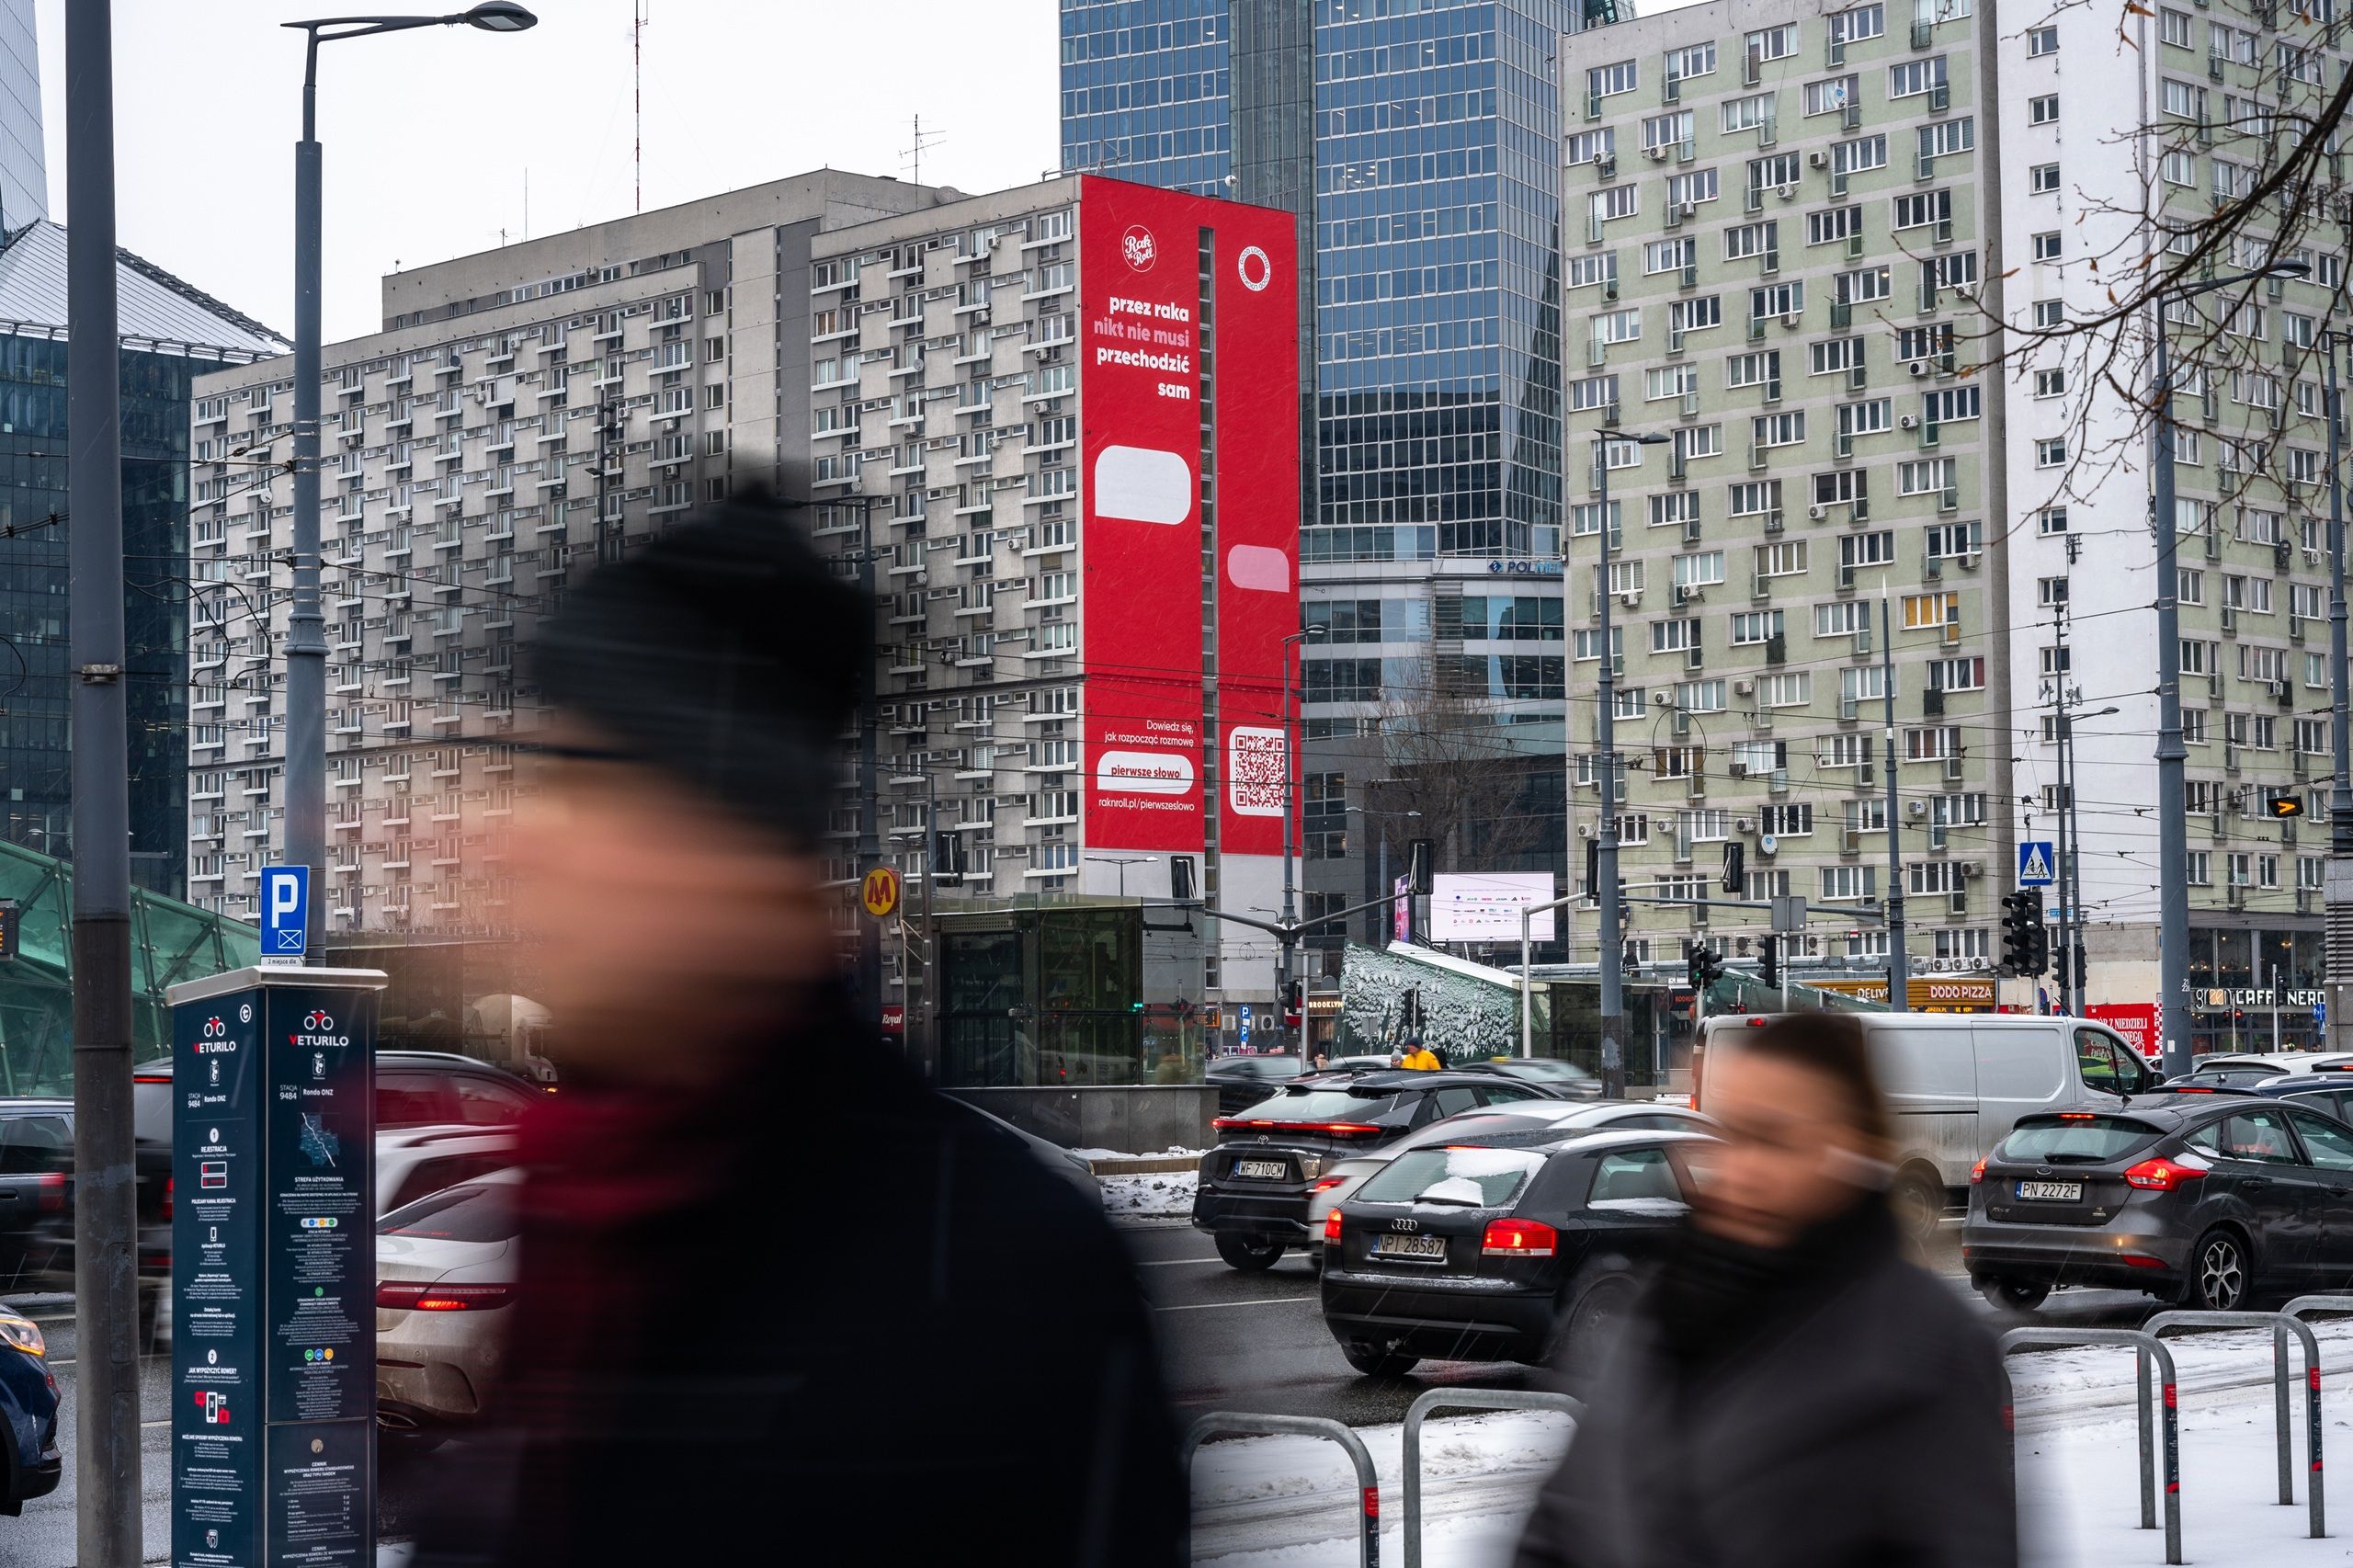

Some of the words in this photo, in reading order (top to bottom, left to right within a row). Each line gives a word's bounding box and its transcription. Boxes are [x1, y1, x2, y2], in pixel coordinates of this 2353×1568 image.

[1125, 234, 1153, 254] Rak
[1133, 247, 1154, 266] Roll
[1240, 248, 1250, 264] GOOD
[1251, 248, 1269, 269] LOOKING
[1240, 268, 1258, 289] LOOKING
[1259, 273, 1269, 288] GOOD
[1109, 296, 1151, 316] przez
[1154, 302, 1189, 322] raka
[1094, 317, 1124, 338] nikt
[1127, 322, 1150, 341] nie
[1154, 330, 1190, 348] musi
[1097, 347, 1190, 374] przechodzić
[1158, 382, 1190, 400] sam
[1147, 720, 1179, 732] Dowiedz
[1181, 723, 1194, 734] się,
[1104, 731, 1116, 743] jak
[1118, 734, 1158, 747] rozpocząć
[1160, 738, 1194, 748] rozmowę
[1111, 765, 1151, 778] pierwsze
[1154, 766, 1180, 779] słowo
[1099, 798, 1195, 812] raknroll.pl/pierwszeslowo
[271, 874, 298, 928] P
[1930, 986, 1959, 999] DODO
[1961, 986, 1992, 999] PIZZA
[2196, 989, 2232, 1009] green
[2236, 990, 2273, 1004] CAFF
[1242, 1008, 1249, 1016] P
[882, 1014, 902, 1026] Royal
[2114, 1018, 2147, 1029] NIEDZIELI
[1242, 1027, 1247, 1036] P
[193, 1041, 236, 1053] VETURILO
[289, 1035, 349, 1046] VETURILO
[1240, 1163, 1252, 1174] WF
[1254, 1164, 1284, 1176] 710CM
[2023, 1183, 2038, 1196] PN
[2041, 1184, 2078, 1198] 2272F
[1379, 1236, 1399, 1252] NPI
[1404, 1238, 1443, 1255] 28587
